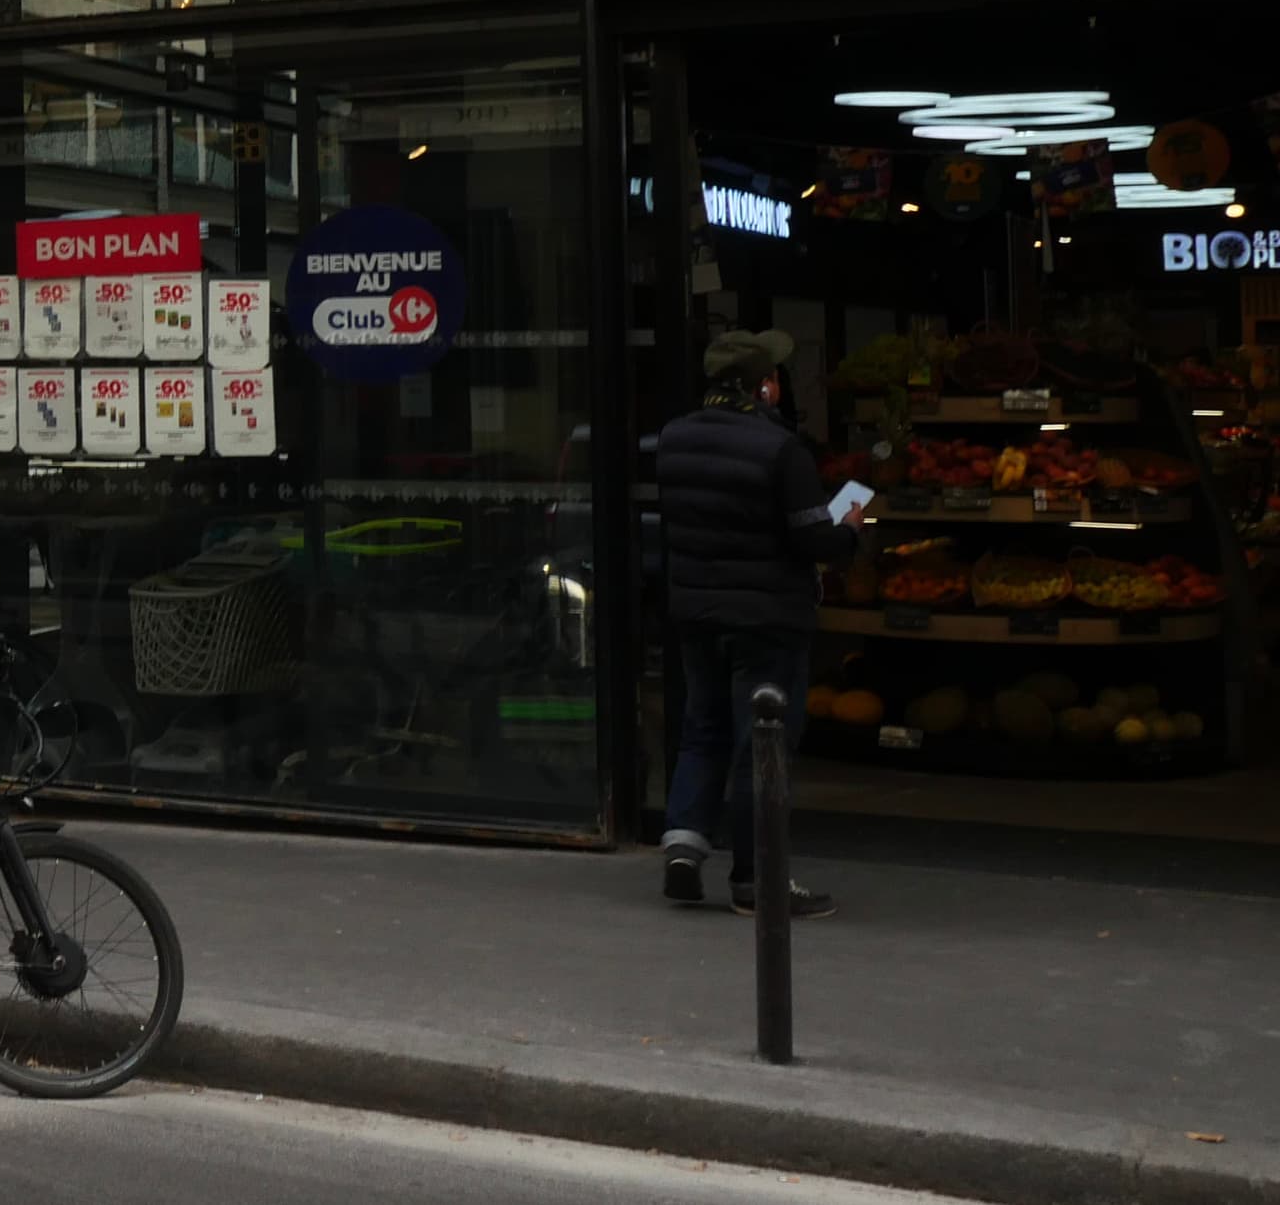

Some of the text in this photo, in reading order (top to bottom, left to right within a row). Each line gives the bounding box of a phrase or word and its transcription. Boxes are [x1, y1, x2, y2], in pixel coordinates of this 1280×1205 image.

[36, 231, 179, 261] BON PLAN
[1162, 230, 1251, 272] BIO
[307, 251, 442, 274] BIENVENUE
[356, 272, 390, 292] AU
[328, 310, 385, 329] Club
